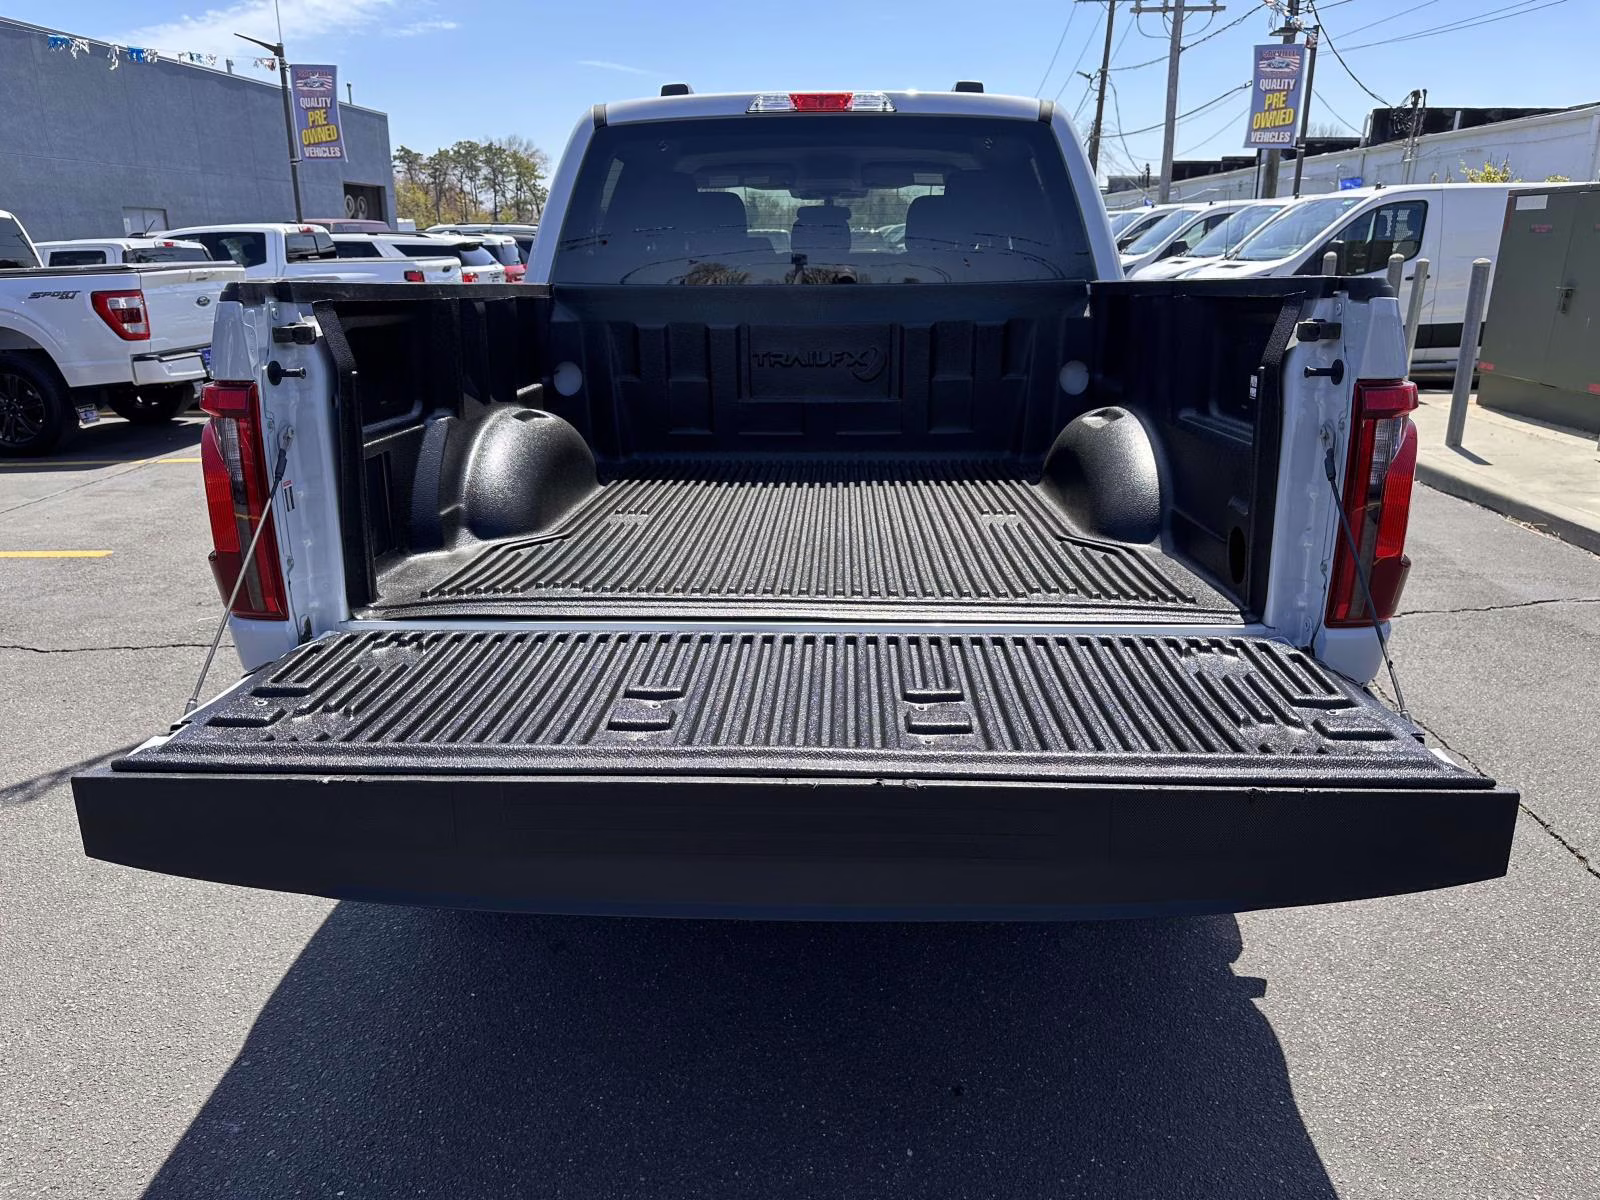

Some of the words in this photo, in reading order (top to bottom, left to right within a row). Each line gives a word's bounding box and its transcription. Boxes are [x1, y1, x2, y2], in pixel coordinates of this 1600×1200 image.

[1259, 79, 1295, 91] QUALITY
[300, 98, 331, 108] QUALITY
[1264, 91, 1286, 109] PRE
[308, 109, 328, 127] PRE
[1253, 109, 1293, 129] OWNED
[302, 126, 337, 144] OWNED
[1251, 131, 1291, 143] VEHICLES
[304, 146, 341, 158] VEHICLES
[751, 350, 870, 370] TRAILFX
